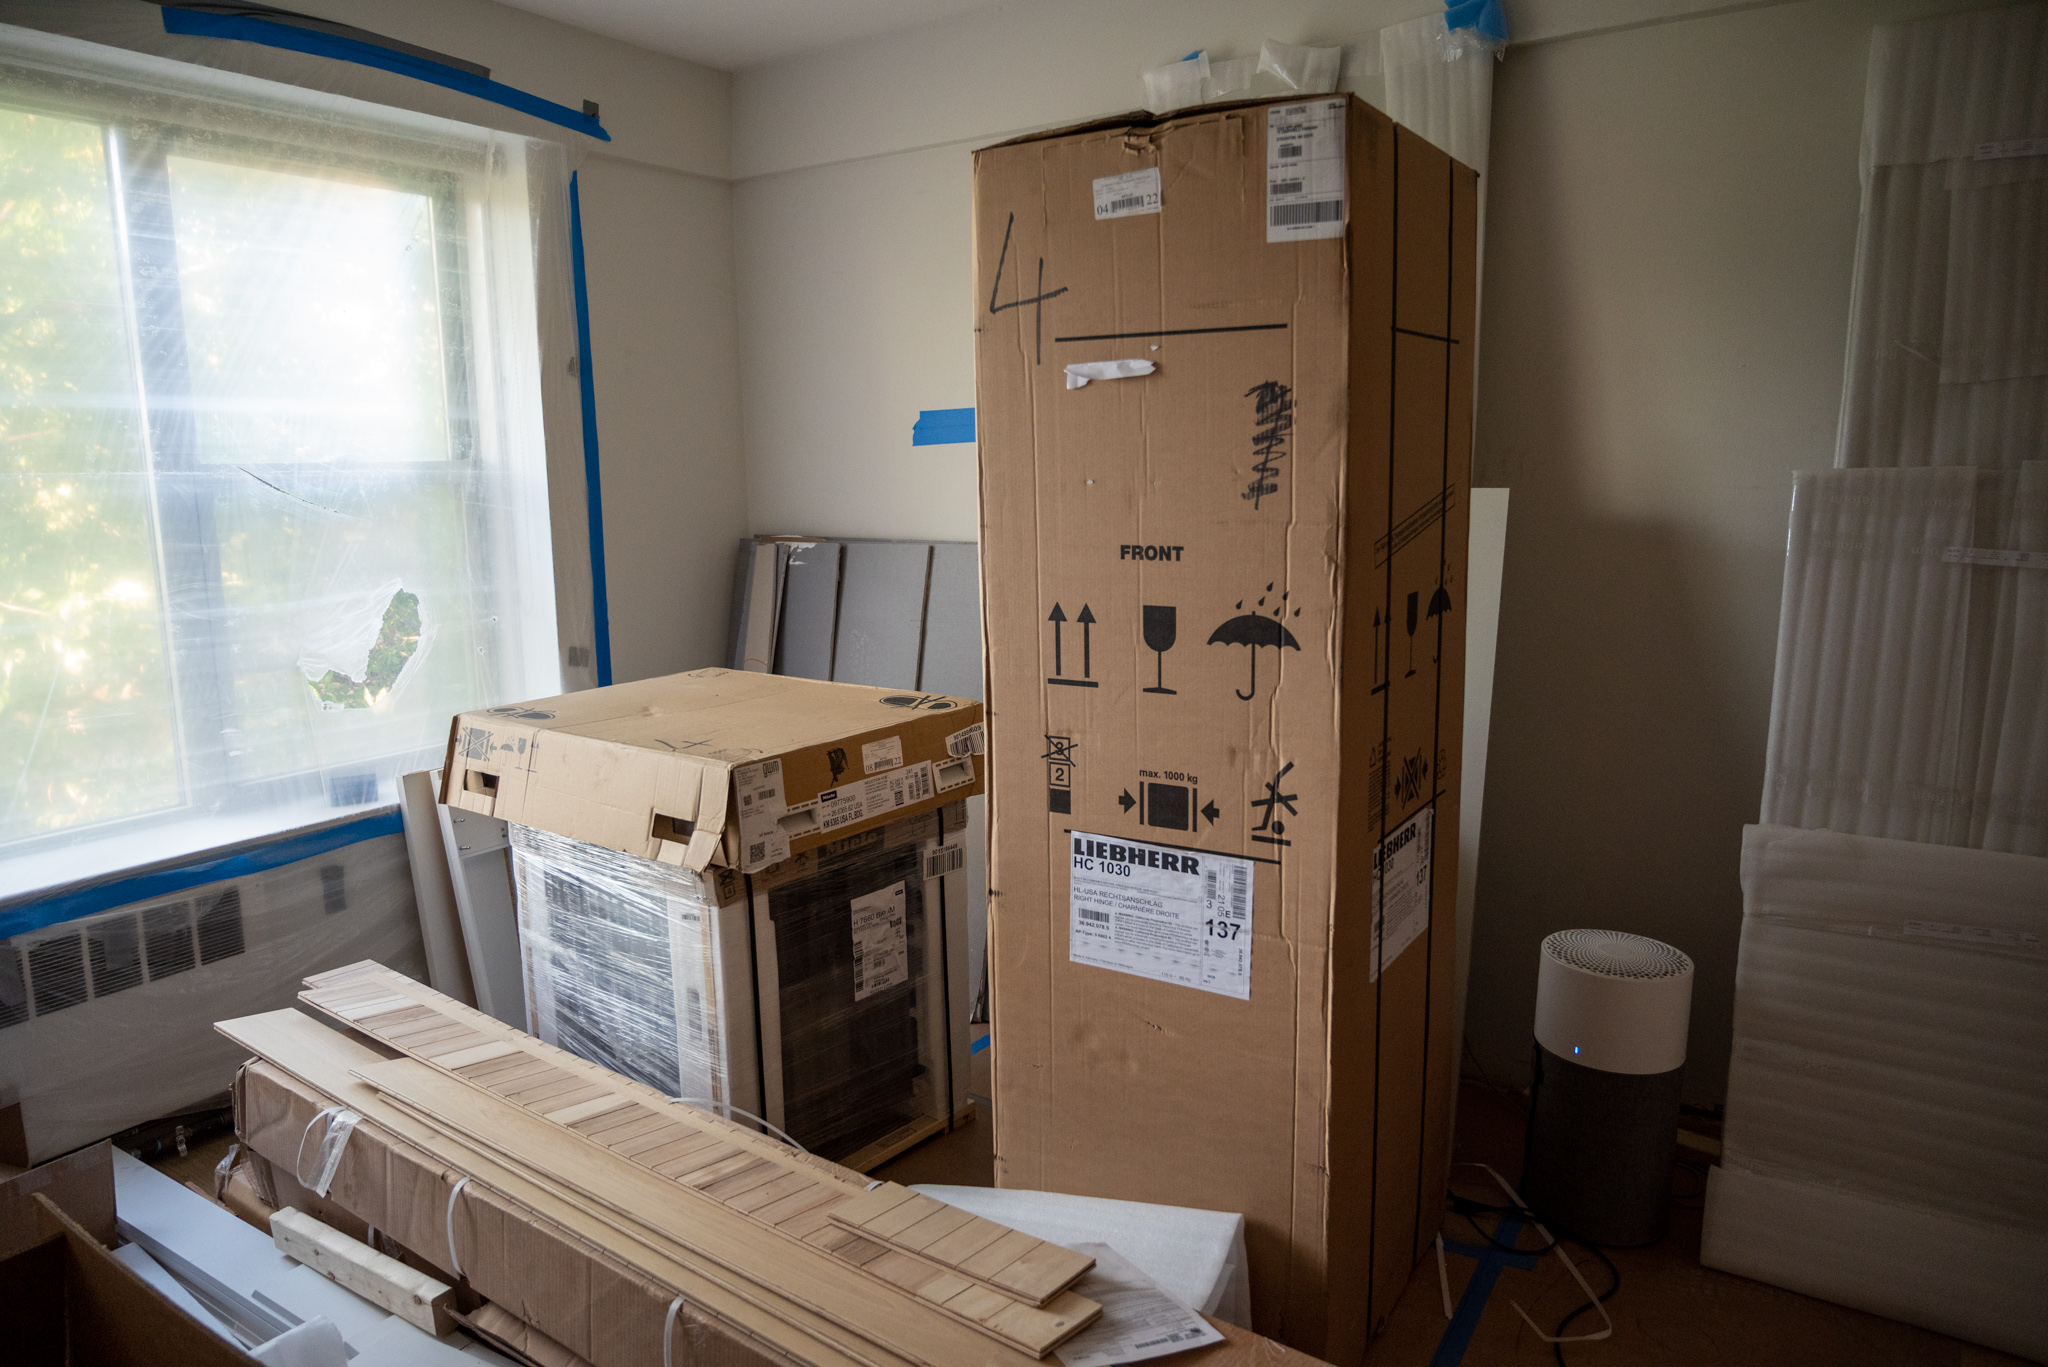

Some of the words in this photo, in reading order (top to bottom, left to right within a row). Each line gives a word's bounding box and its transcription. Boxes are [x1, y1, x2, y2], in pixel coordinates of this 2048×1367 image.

[1146, 193, 1159, 205] 22
[1097, 204, 1108, 216] 04
[989, 212, 1068, 365] 4
[1120, 544, 1185, 561] FRONT
[763, 760, 780, 778] gwm
[1055, 768, 1065, 782] 2
[1139, 769, 1161, 779] max.
[1163, 771, 1185, 782] 1000
[1187, 773, 1198, 785] kg
[854, 802, 863, 811] USA
[840, 815, 849, 825] USA
[1074, 838, 1200, 876] LIEBHERR
[1074, 856, 1094, 871] HC
[1099, 861, 1131, 877] 1030
[1416, 864, 1427, 887] 137
[1073, 886, 1098, 897] HL-USA
[1099, 891, 1163, 909] RECHTSANSCHLAG
[1206, 900, 1213, 909] 3
[1217, 894, 1226, 905] 21
[1073, 894, 1092, 904] RIGHT
[1093, 897, 1114, 907] HINGE
[1118, 900, 1155, 916] CHARNIÈRE
[1155, 907, 1180, 920] DROITE
[1217, 906, 1225, 917] 05
[860, 914, 875, 925] 7660
[1205, 919, 1241, 941] 137
